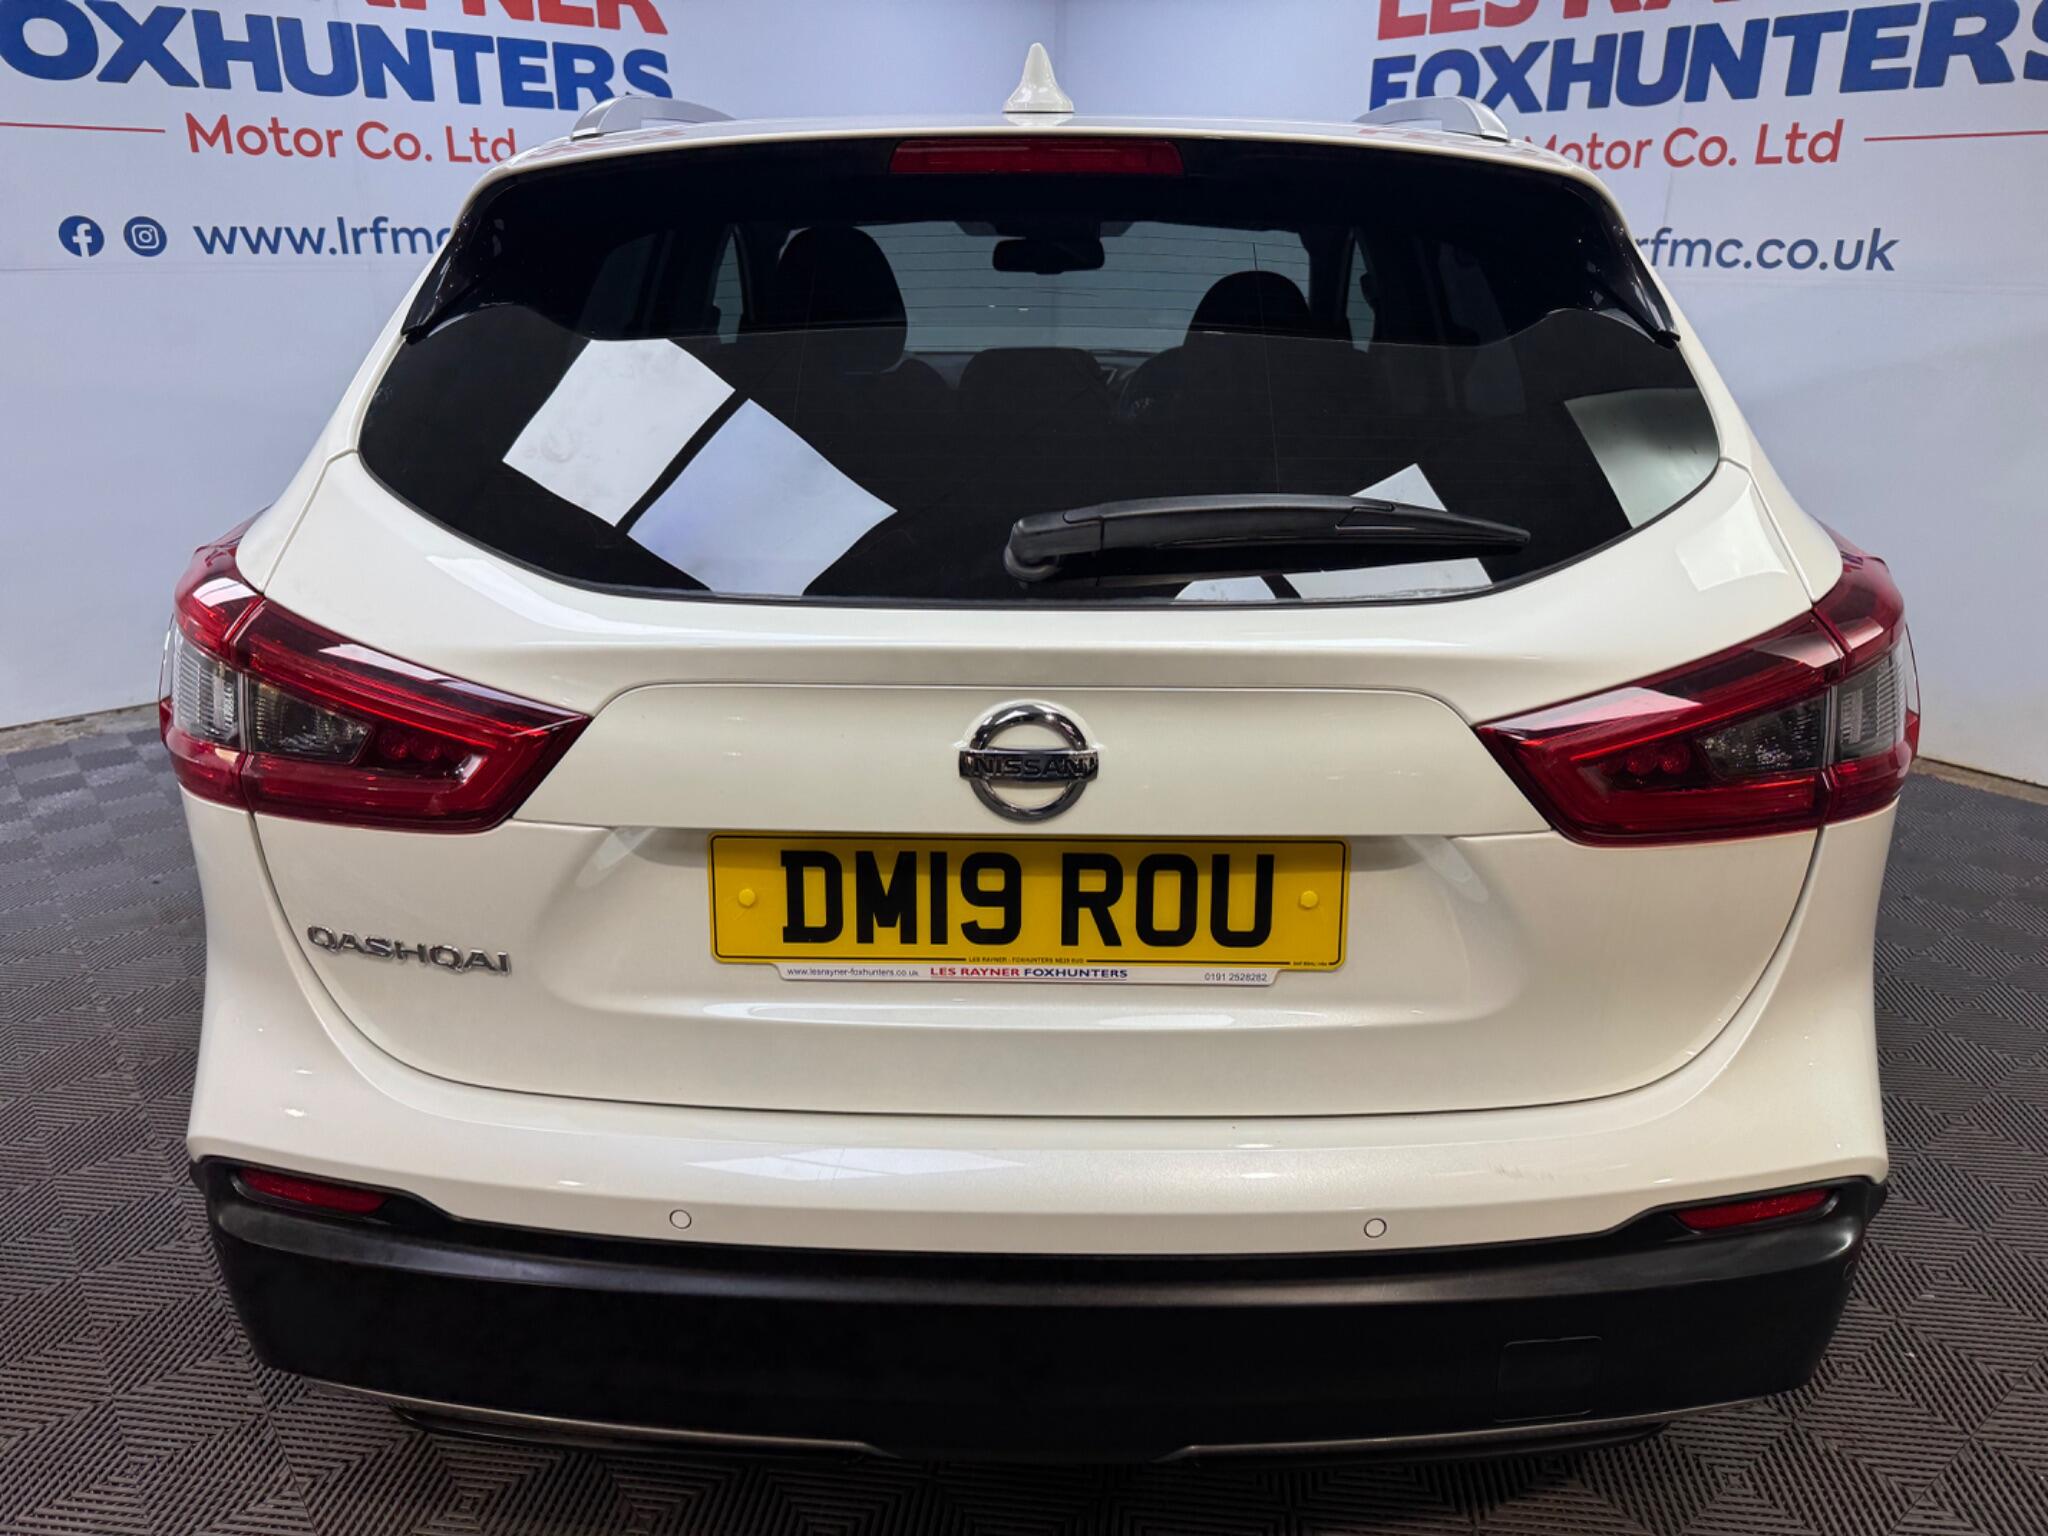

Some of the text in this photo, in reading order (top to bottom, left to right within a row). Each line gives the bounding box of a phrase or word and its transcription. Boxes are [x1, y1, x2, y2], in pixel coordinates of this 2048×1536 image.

[1369, 0, 2048, 114] FOXHUNTER
[185, 112, 516, 164] Motor Co. Ltd
[1663, 127, 1737, 168] Co.
[1755, 118, 1844, 165] Ltd
[972, 756, 1094, 777] NISSAN
[780, 849, 1275, 949] DM19 ROU
[307, 925, 512, 975] QASHQAI
[930, 967, 956, 977] LES
[961, 967, 1020, 978] RAYNER
[1024, 968, 1128, 979] FOXHUNTERS
[1204, 973, 1226, 983] 0191
